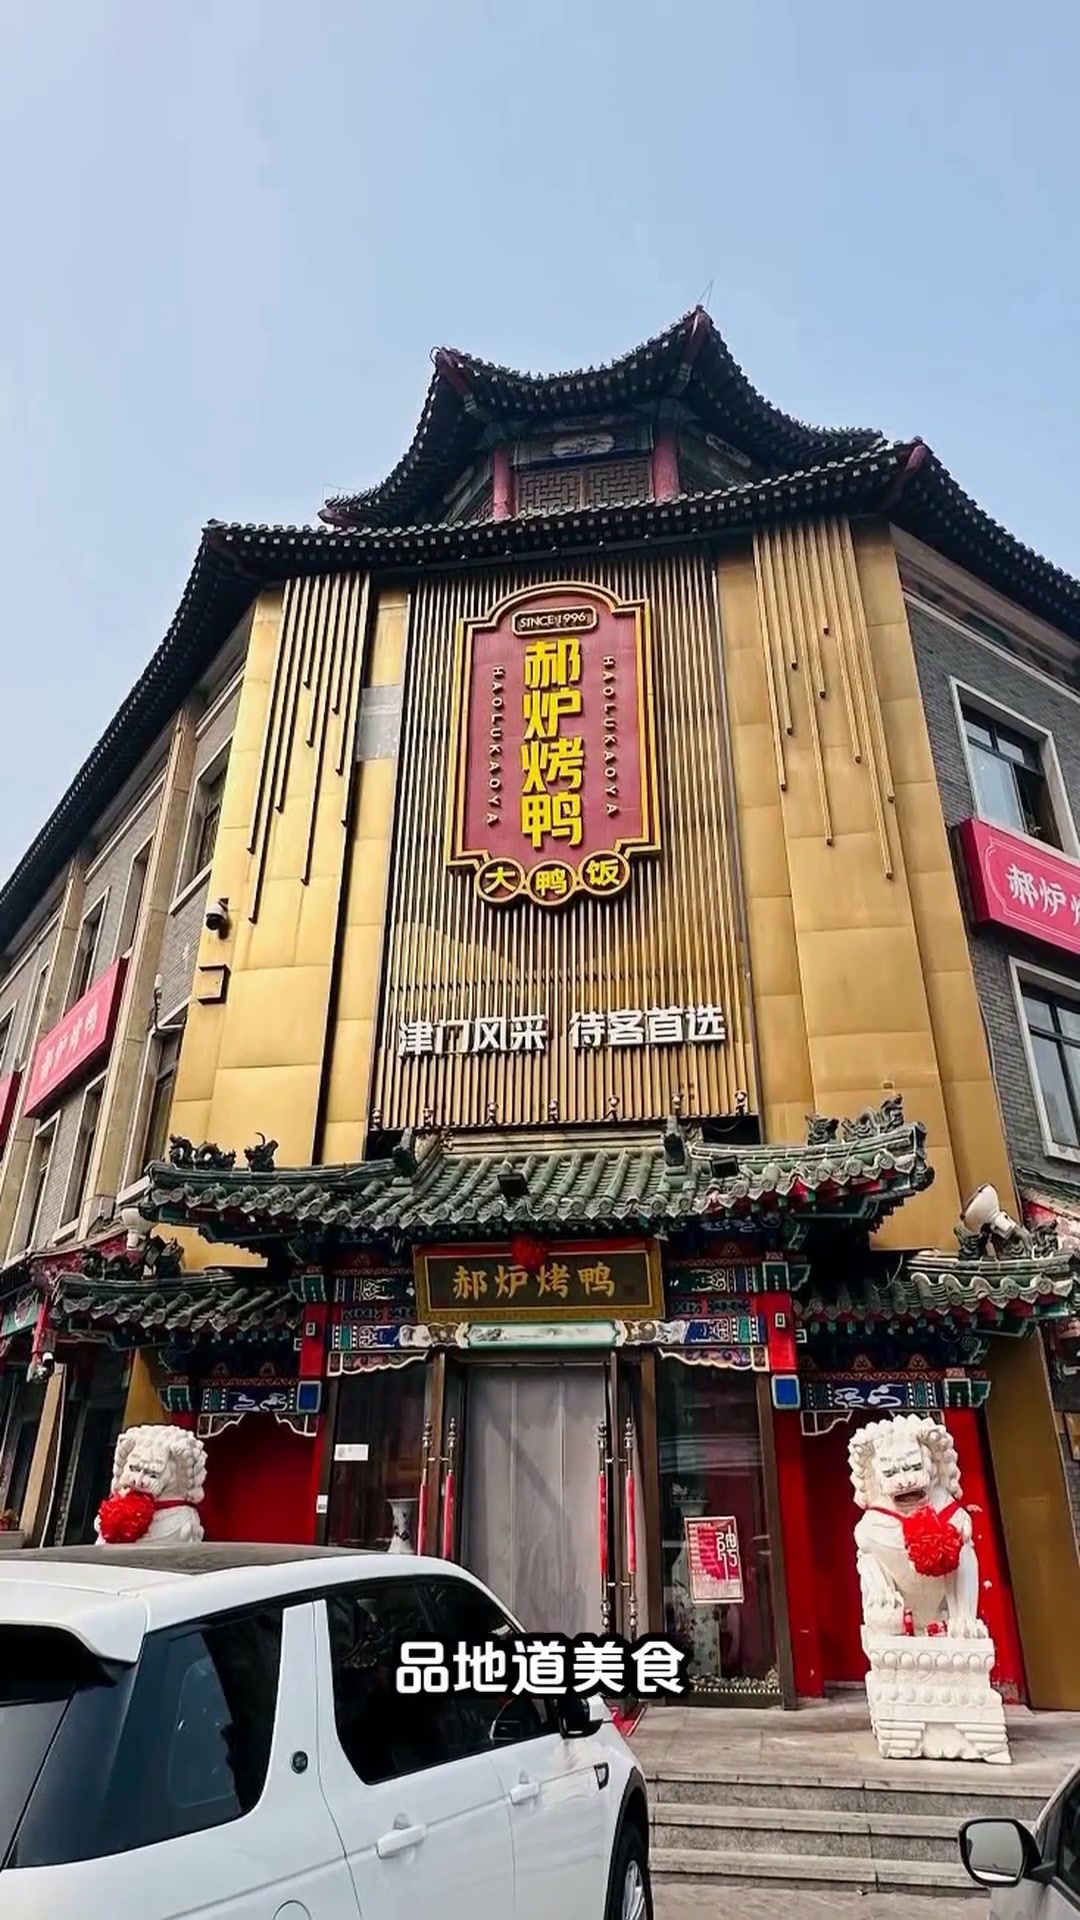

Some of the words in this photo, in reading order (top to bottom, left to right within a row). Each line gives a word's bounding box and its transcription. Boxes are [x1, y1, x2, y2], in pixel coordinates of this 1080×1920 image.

[520, 614, 555, 628] SINCE
[558, 612, 586, 624] 1996
[486, 665, 505, 826] HAOLUKAOYA
[522, 638, 584, 847] 郝炉烤鸭
[602, 654, 618, 816] HAOLUKAOYA
[399, 1014, 549, 1056] 津门风采
[569, 1004, 726, 1048] 待客首选
[452, 1262, 615, 1300] 郝炉烤鸭
